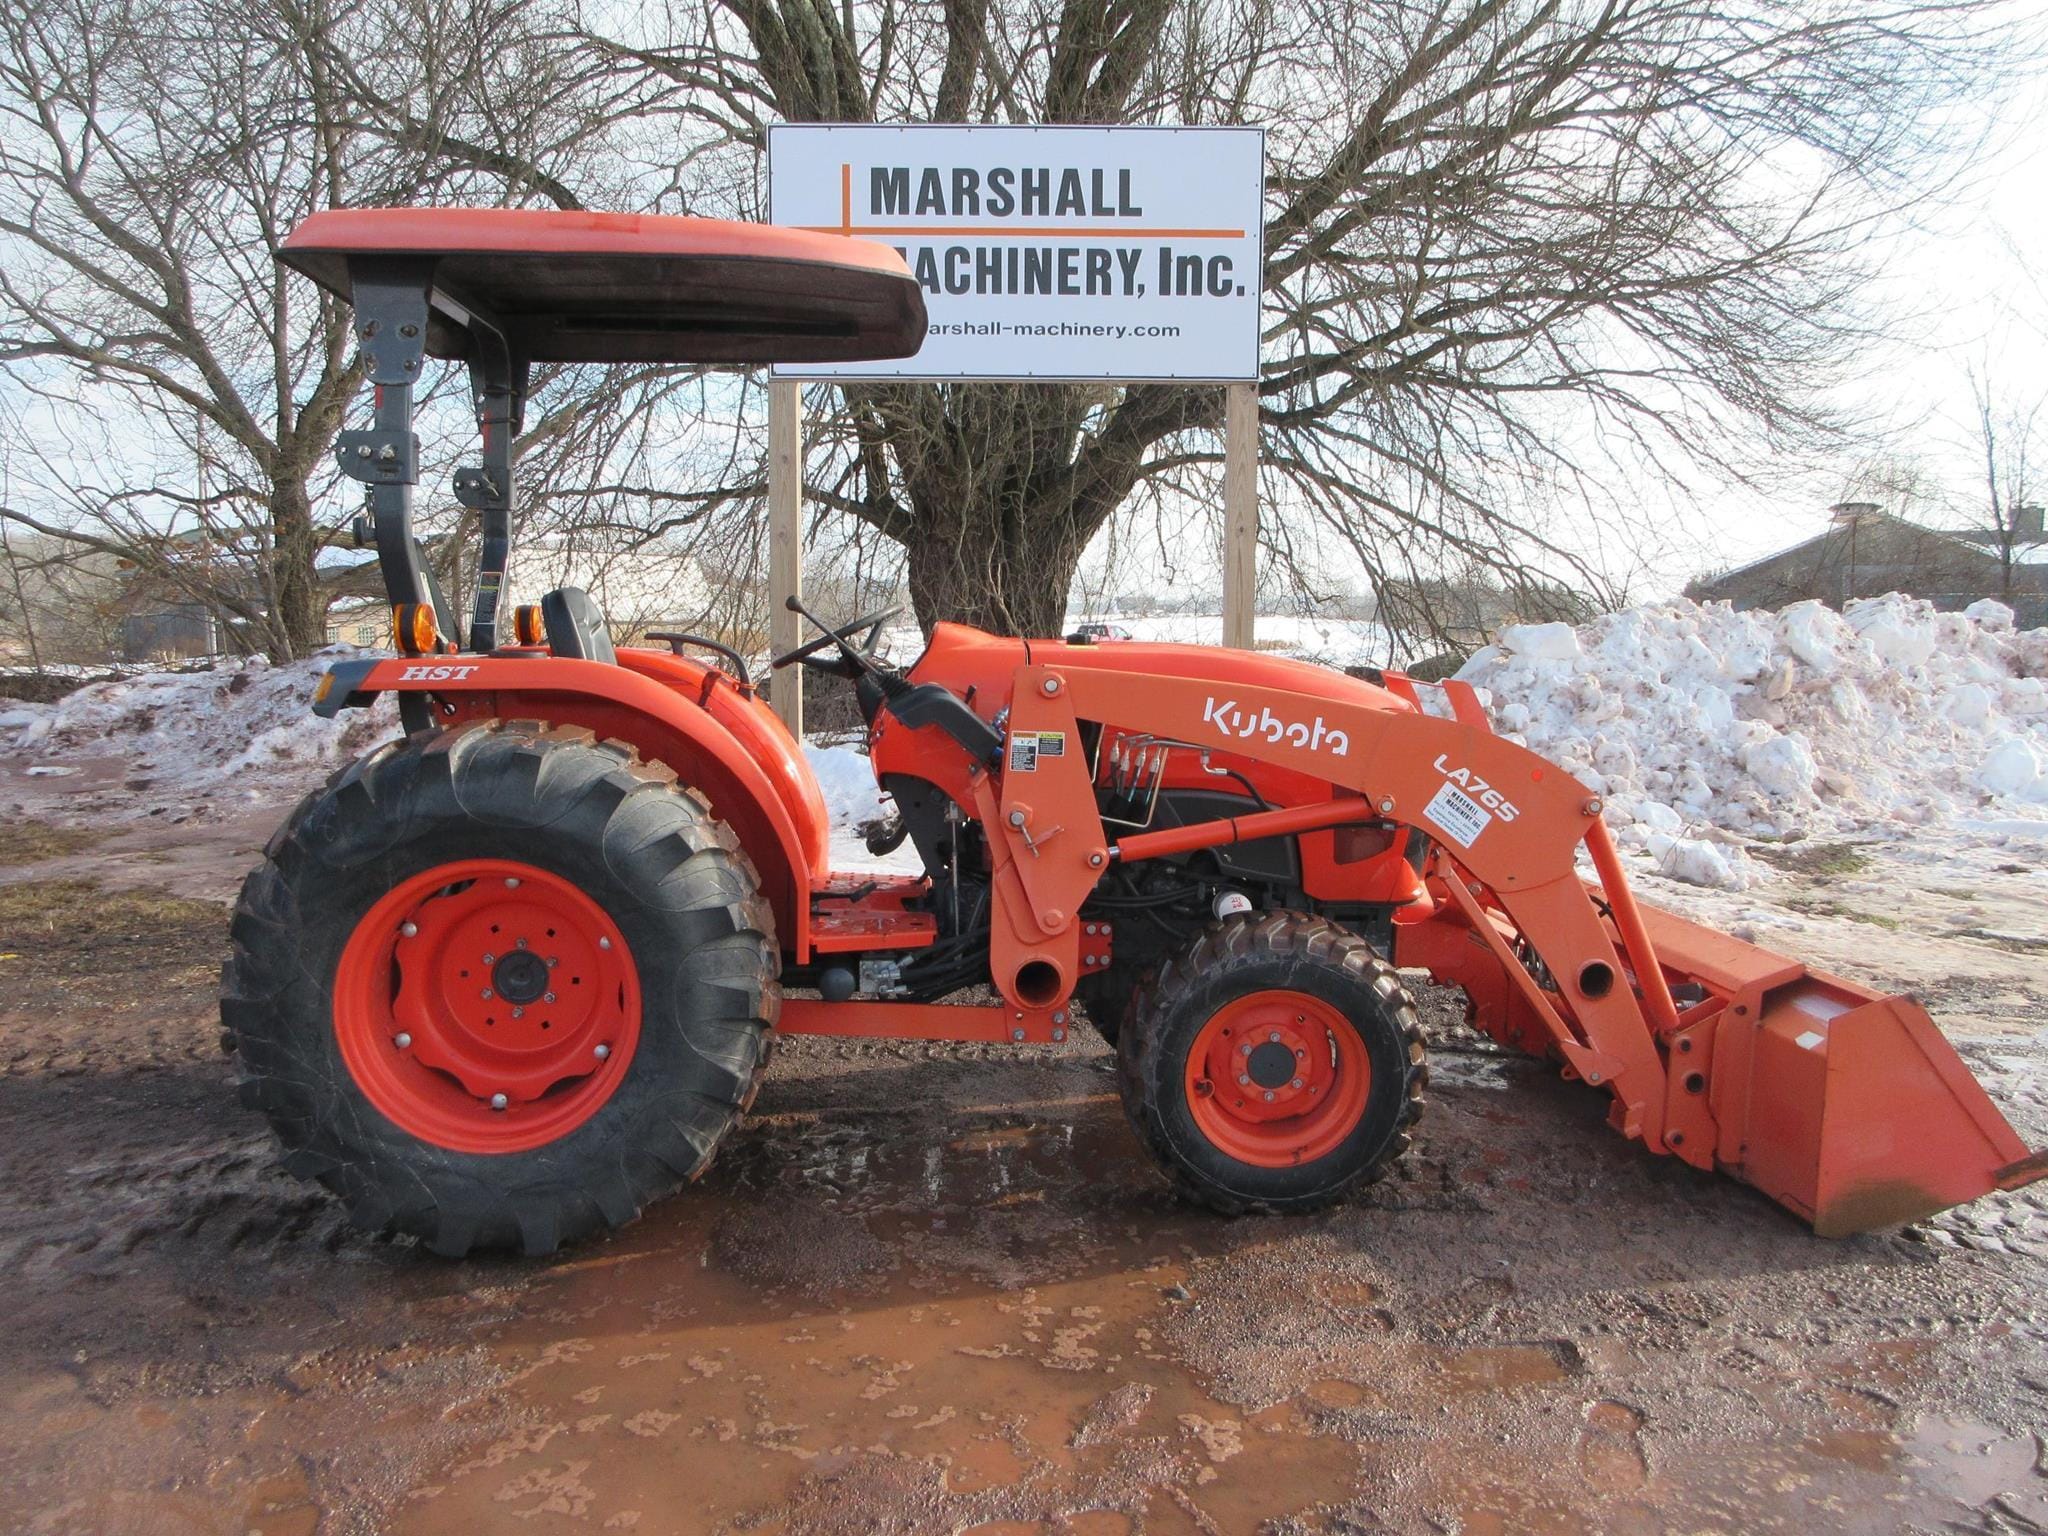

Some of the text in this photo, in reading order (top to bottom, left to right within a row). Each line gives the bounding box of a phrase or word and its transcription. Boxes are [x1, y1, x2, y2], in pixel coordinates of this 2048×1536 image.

[870, 167, 1143, 217] MARSHALL
[894, 246, 1246, 299] ACHINERY, Inc.
[928, 321, 1180, 339] arshall-machinery.com
[398, 665, 479, 681] HST
[1203, 696, 1349, 757] Kubota
[1433, 753, 1520, 822] LA765
